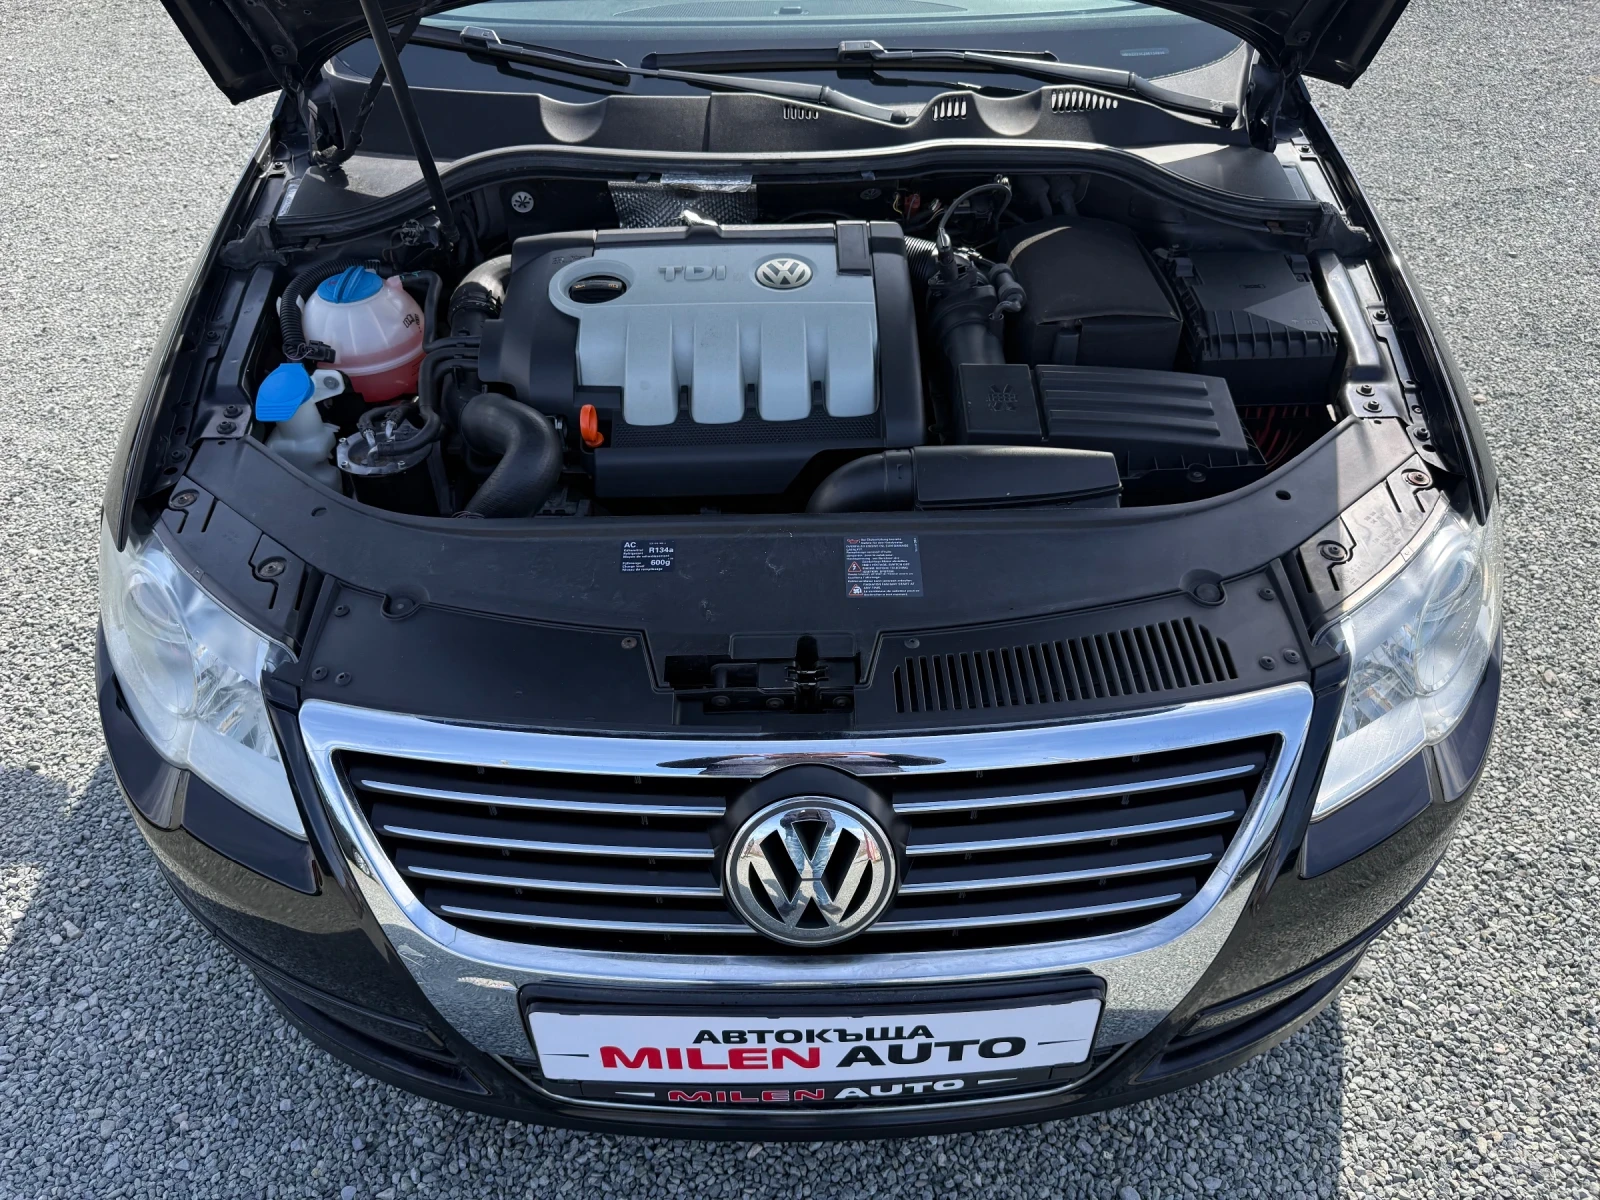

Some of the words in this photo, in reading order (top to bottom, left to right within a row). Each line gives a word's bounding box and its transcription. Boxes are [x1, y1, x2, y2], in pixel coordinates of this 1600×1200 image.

[658, 265, 726, 282] TDI
[692, 1024, 935, 1045] АВТОКЪША
[600, 1046, 820, 1070] MILEN
[836, 1036, 1027, 1068] AUTO
[667, 1089, 825, 1102] MILEN
[834, 1079, 965, 1100] AUTO
